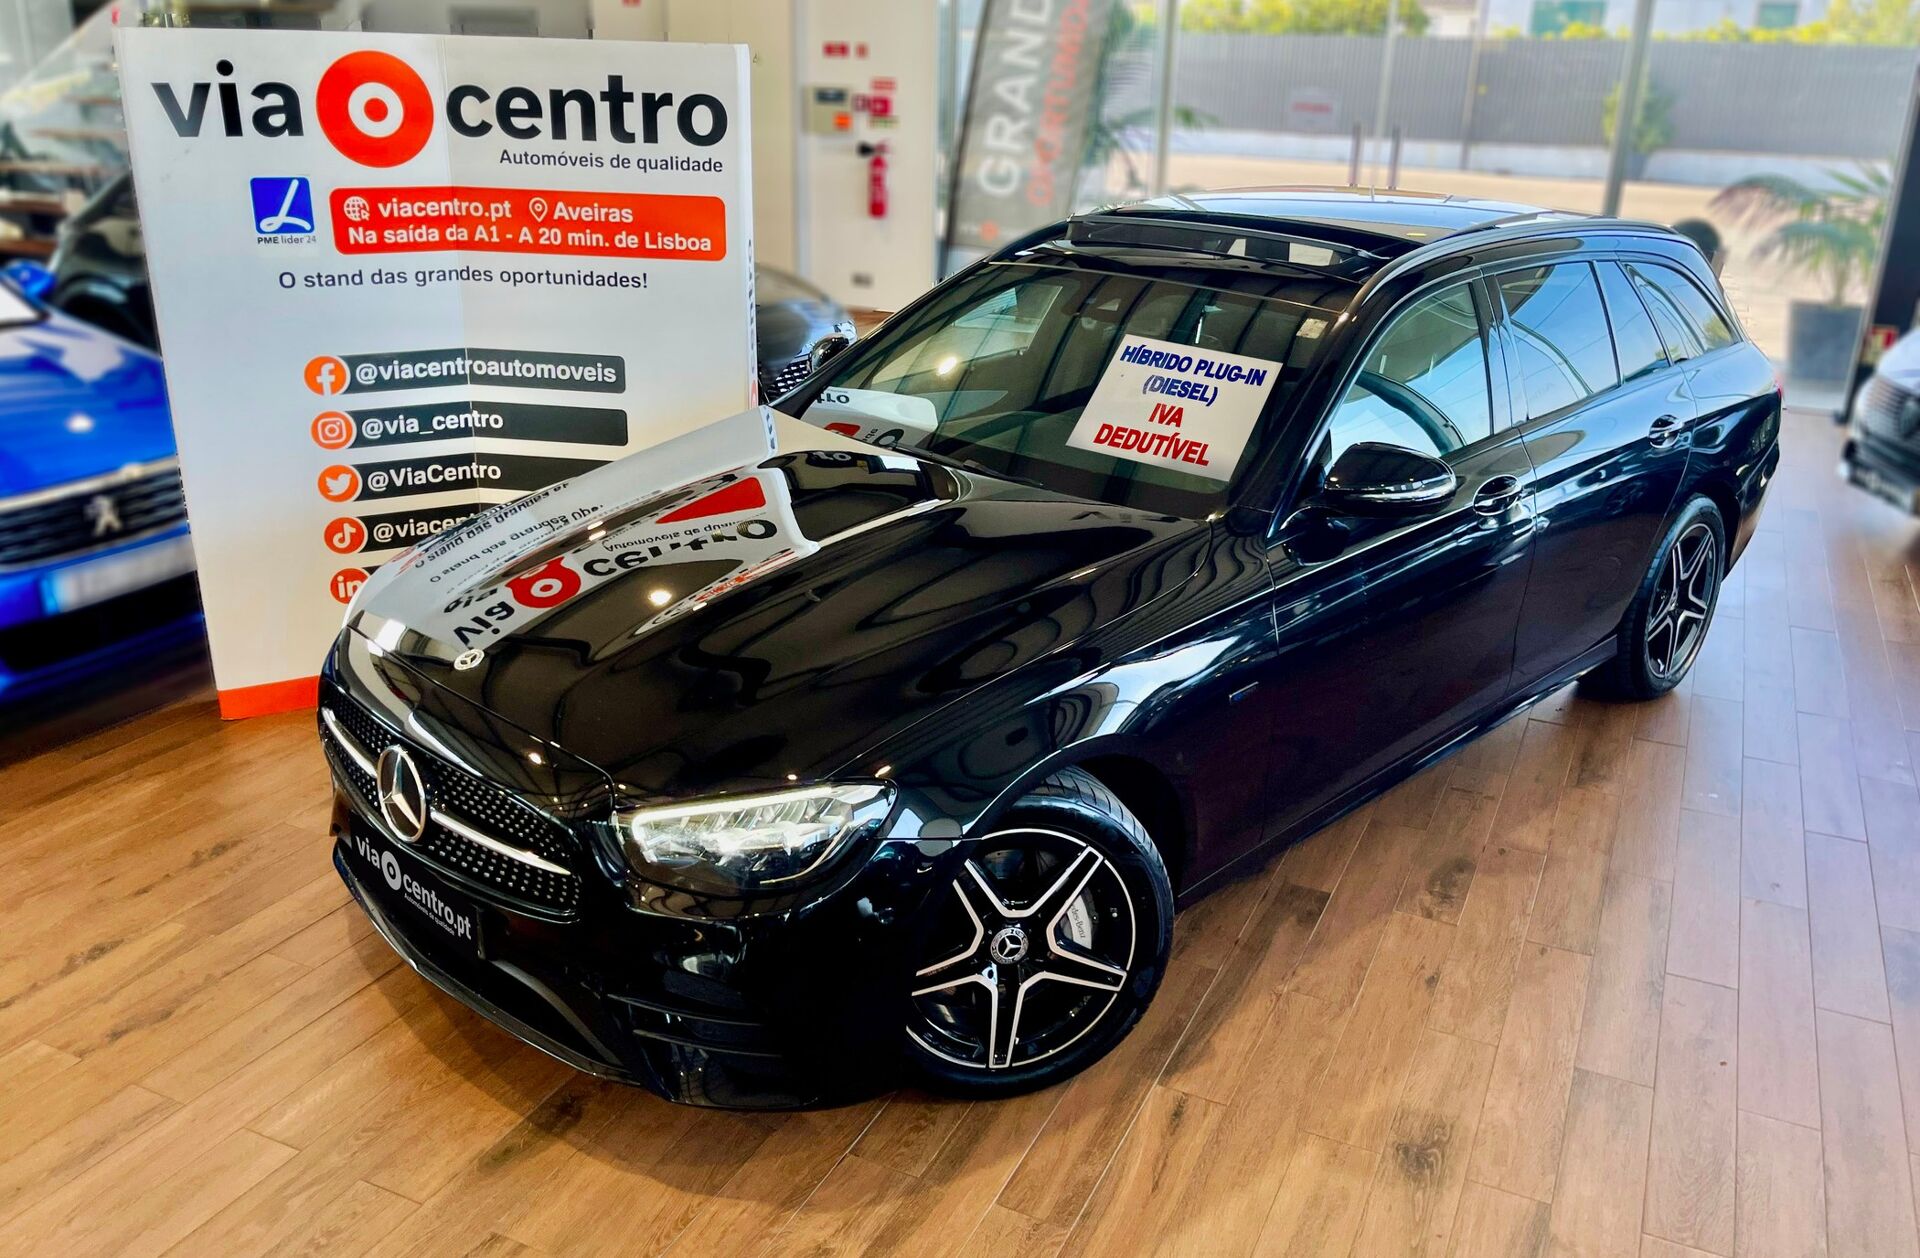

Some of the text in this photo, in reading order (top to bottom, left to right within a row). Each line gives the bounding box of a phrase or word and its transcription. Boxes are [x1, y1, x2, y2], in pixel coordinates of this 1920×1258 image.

[151, 59, 728, 147] via centro
[499, 149, 723, 173] Automóveis de qualidade
[378, 197, 512, 222] viacentro.pt
[553, 201, 633, 223] Aveiras
[257, 236, 279, 245] PME
[348, 227, 377, 244] Na
[384, 224, 439, 243] saída
[445, 225, 468, 241] da
[474, 225, 500, 242] A1
[518, 227, 533, 244] A
[539, 228, 561, 246] 20
[567, 229, 610, 248] min.
[614, 231, 638, 249] de
[645, 232, 711, 252] Lisboa
[279, 266, 648, 289] O stand das grandes oportunidades!
[356, 357, 617, 385] @viacentroautomoveis
[1119, 344, 1268, 387] HÍBRIDO PLUG-IN
[1141, 374, 1219, 407] (DIESEL)
[361, 410, 504, 439] @via_centro
[1148, 402, 1185, 428] IVA
[1093, 423, 1210, 467] DEDUTÍVEL
[367, 461, 501, 492] @ViaCentro
[355, 835, 472, 941] via centro.pt
